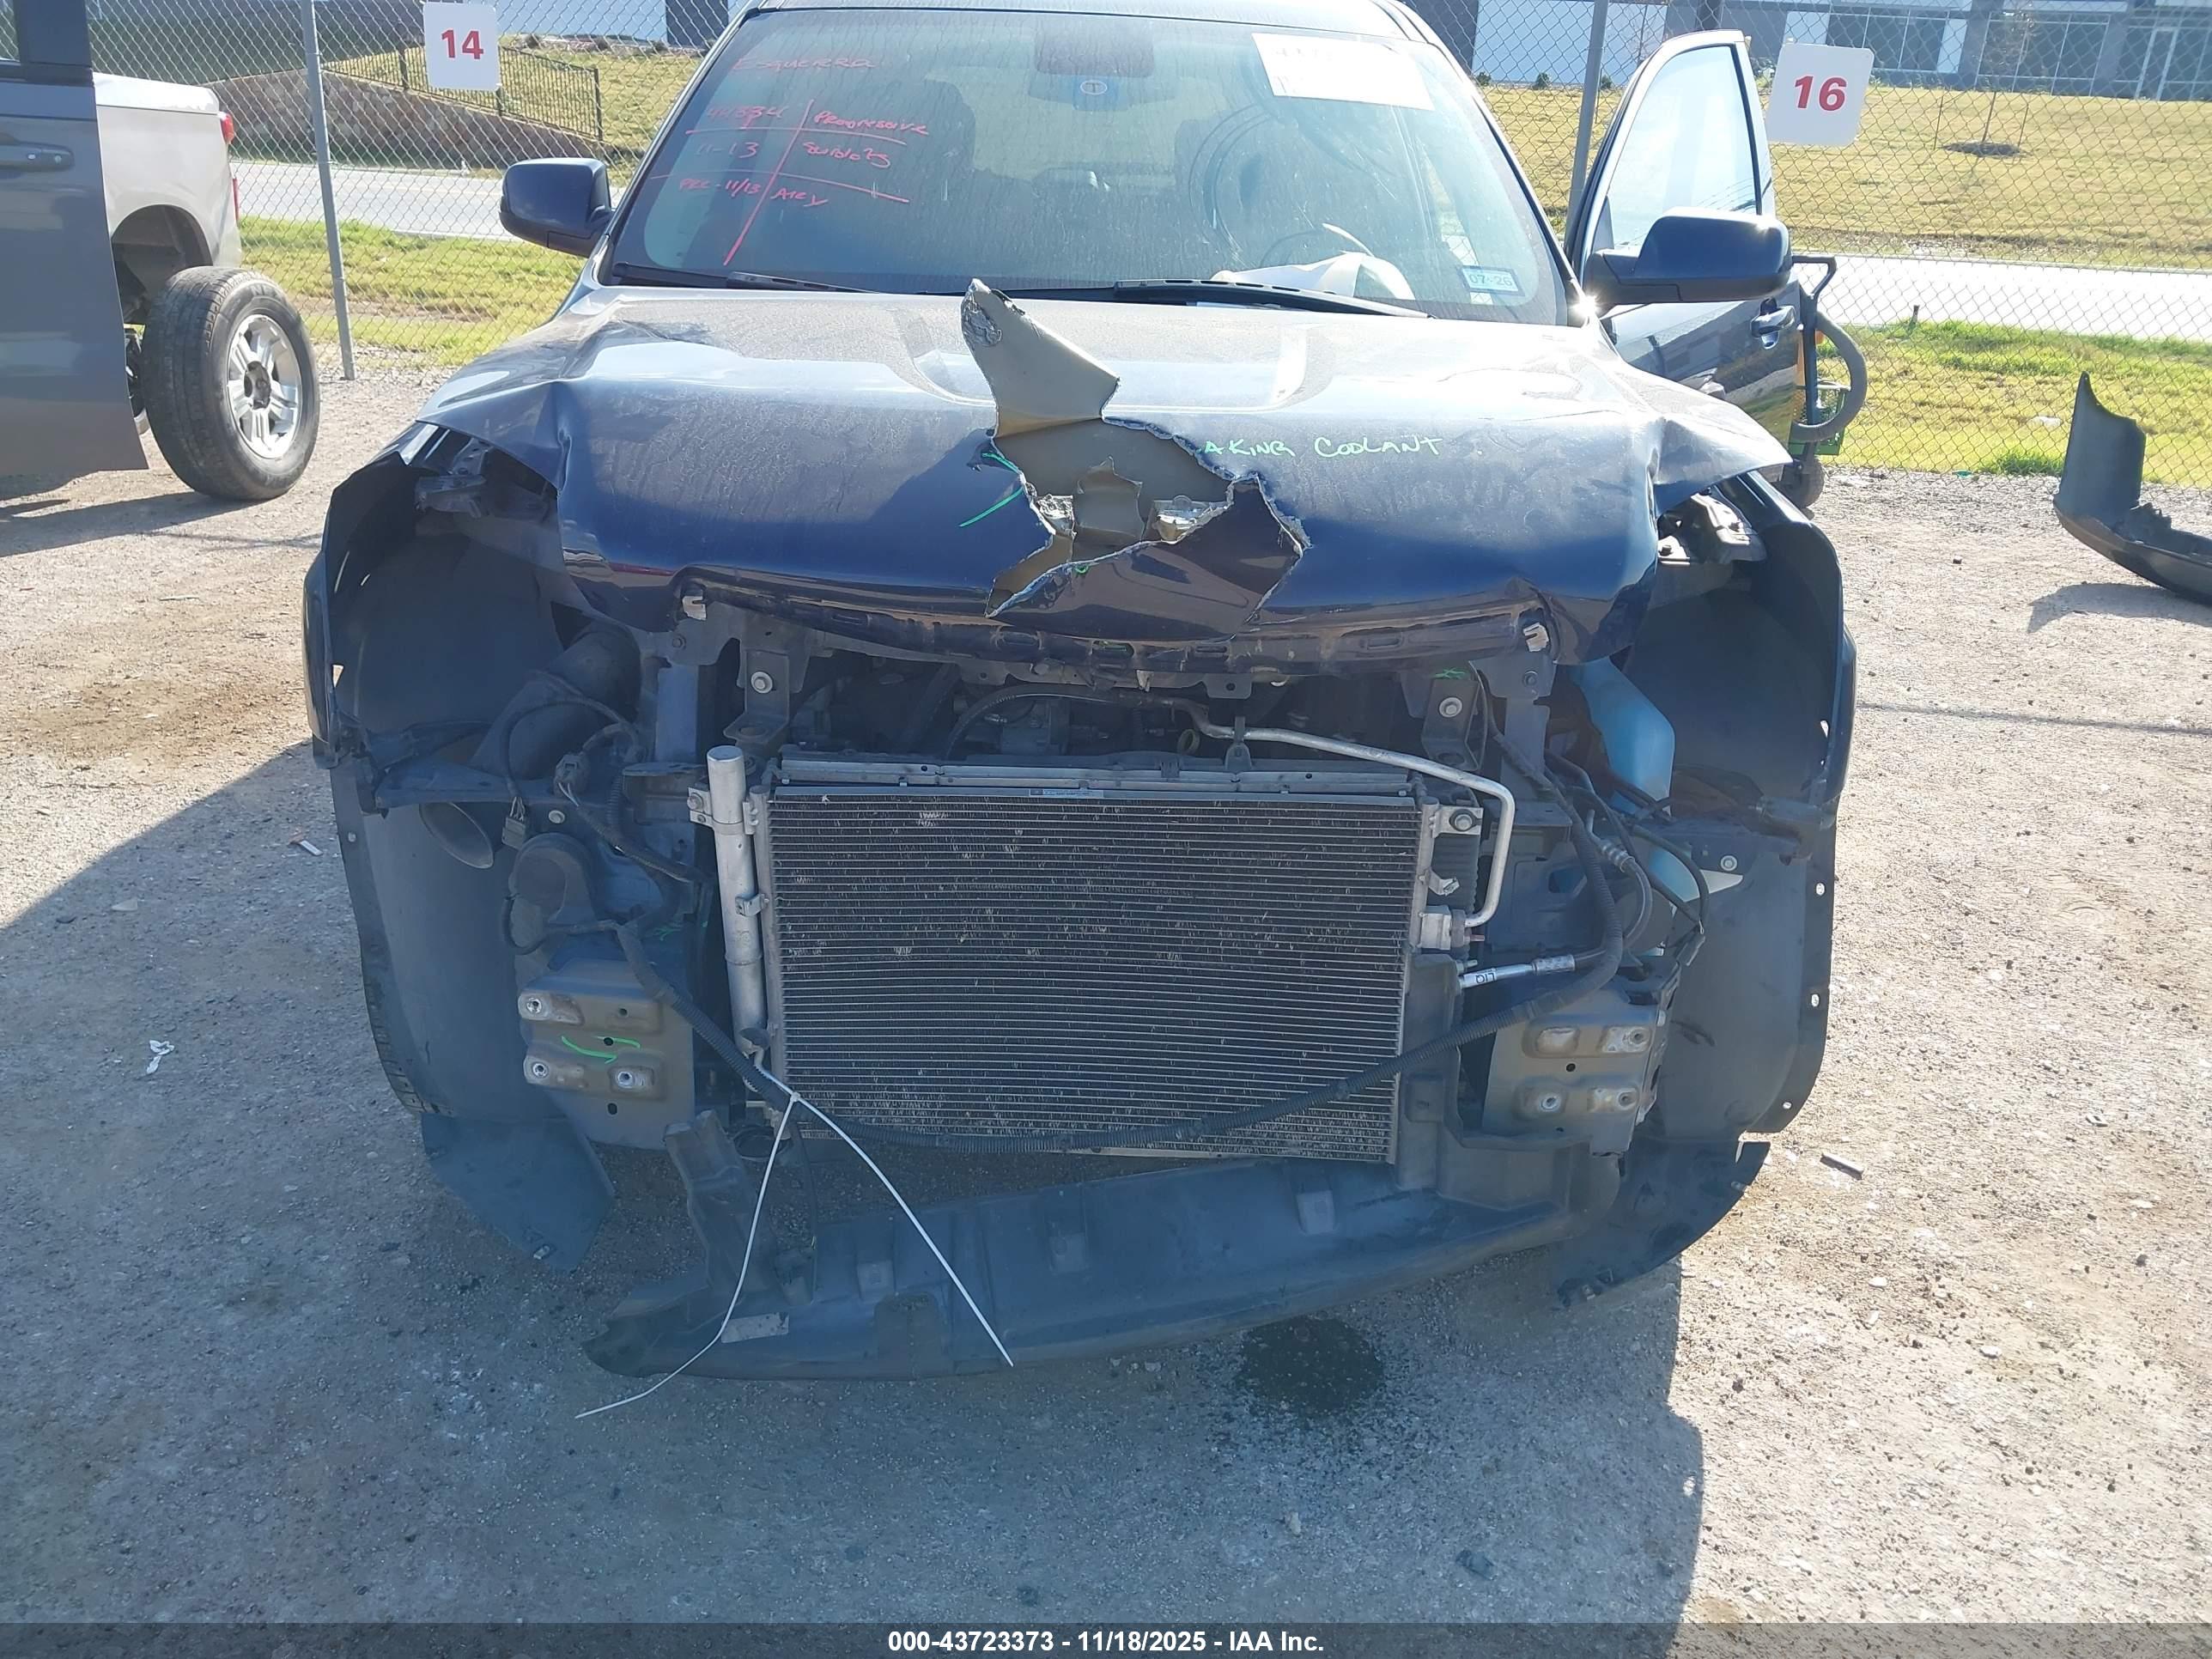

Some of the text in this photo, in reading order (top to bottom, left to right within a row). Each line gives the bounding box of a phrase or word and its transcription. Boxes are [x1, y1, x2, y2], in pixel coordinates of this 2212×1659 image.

[441, 29, 484, 60] 14
[1795, 75, 1847, 112] 16
[1197, 438, 1297, 457] AKING
